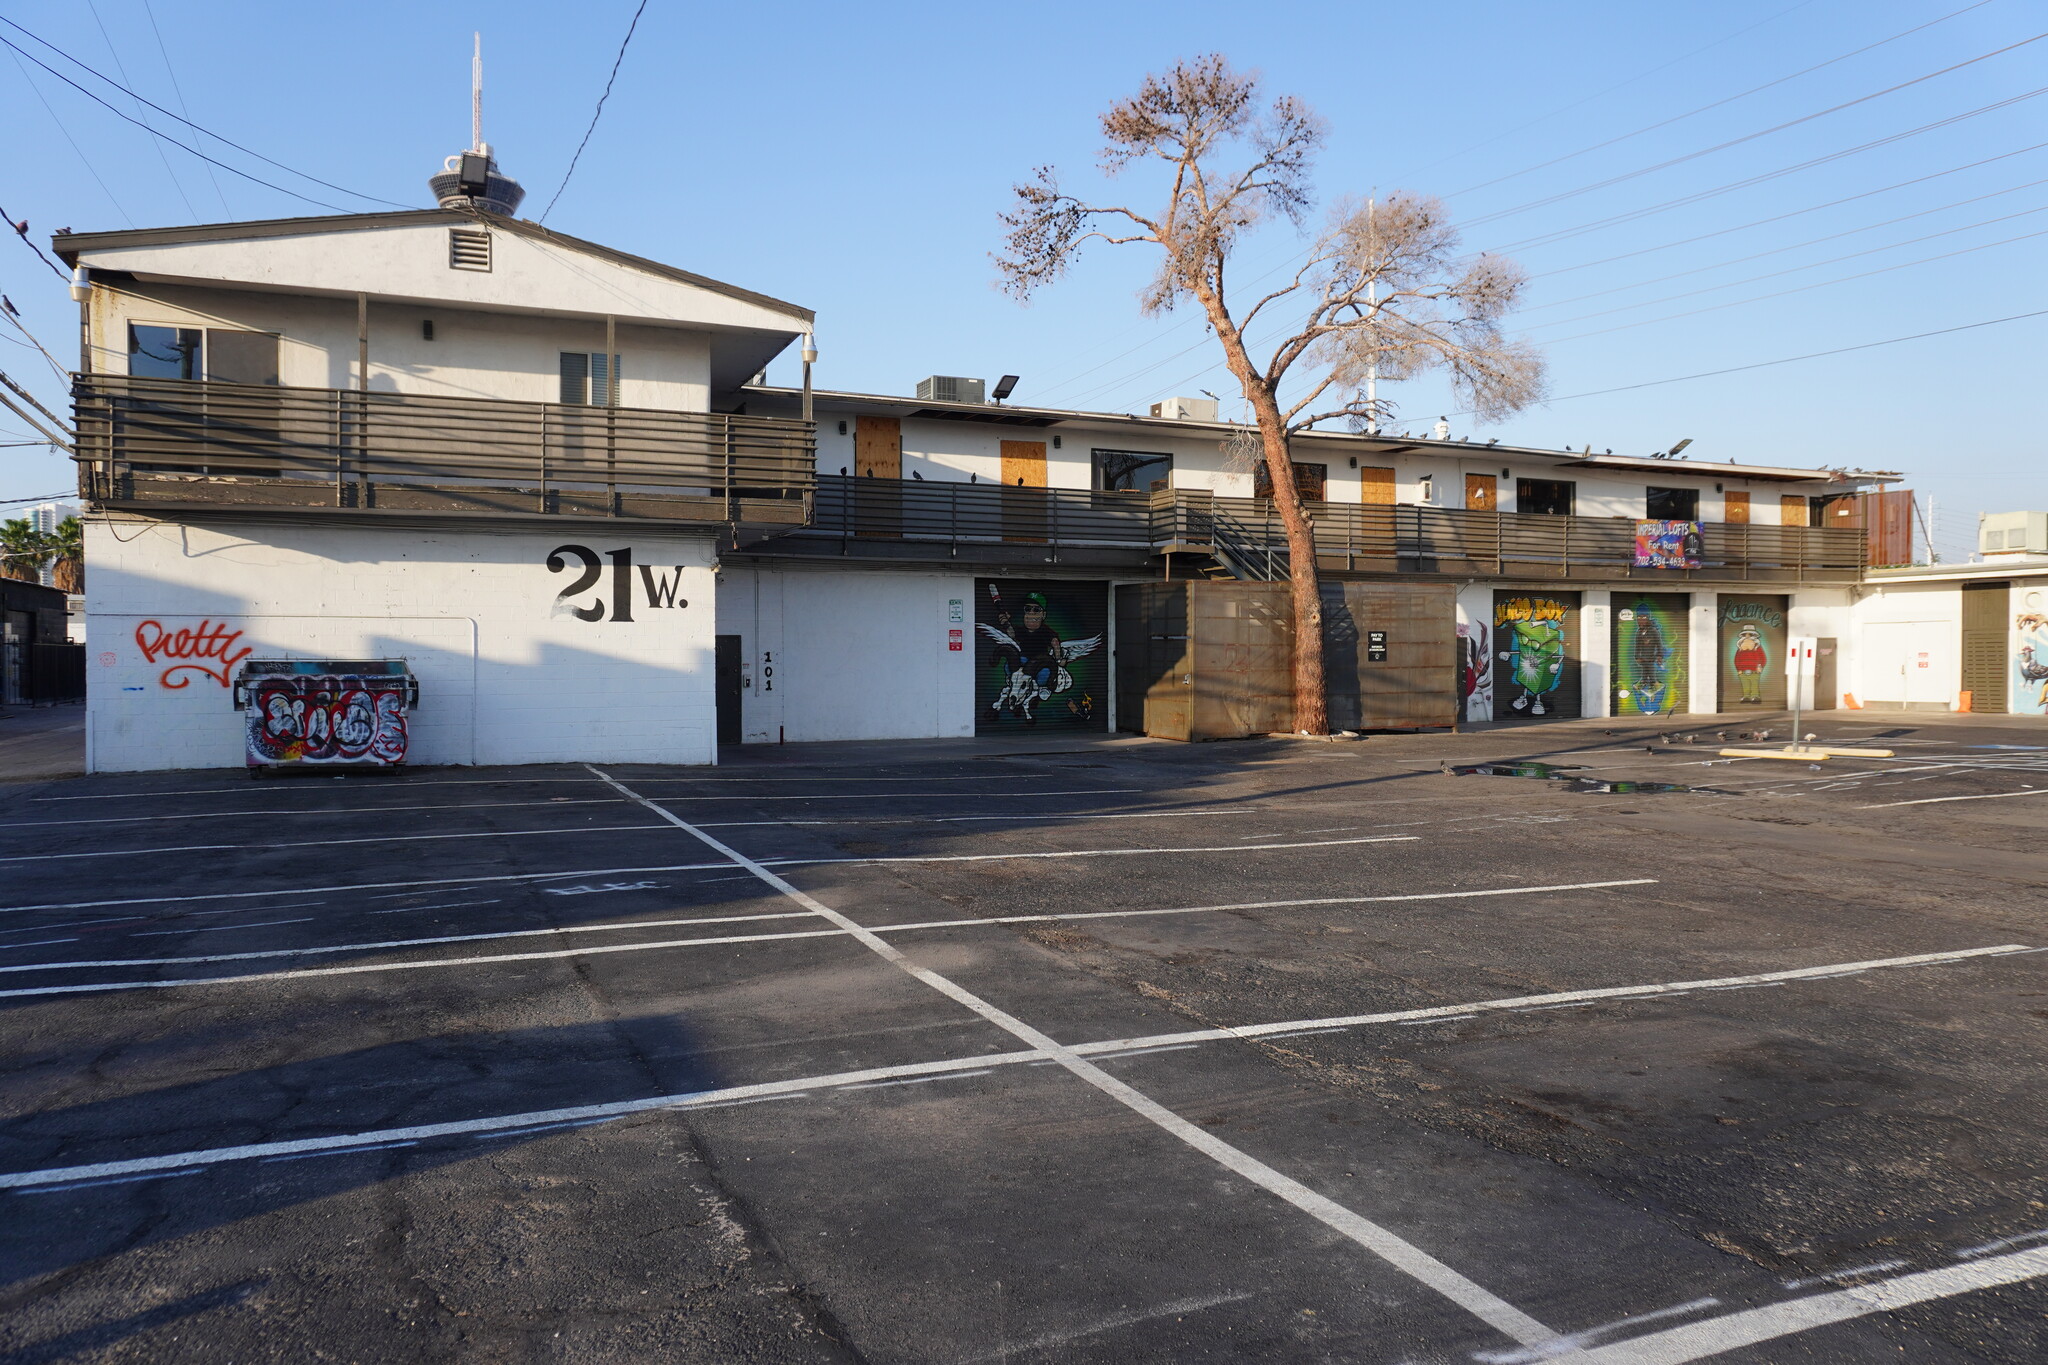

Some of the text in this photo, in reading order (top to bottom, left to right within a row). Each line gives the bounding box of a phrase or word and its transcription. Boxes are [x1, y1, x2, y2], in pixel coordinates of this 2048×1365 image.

[1637, 522, 1689, 536] IMPERIAL LOFTS
[1648, 540, 1680, 550] For Rent
[1637, 556, 1686, 567] 702-534-4633
[546, 544, 635, 622] 21
[135, 619, 253, 689] Pretty
[764, 651, 773, 691] 101
